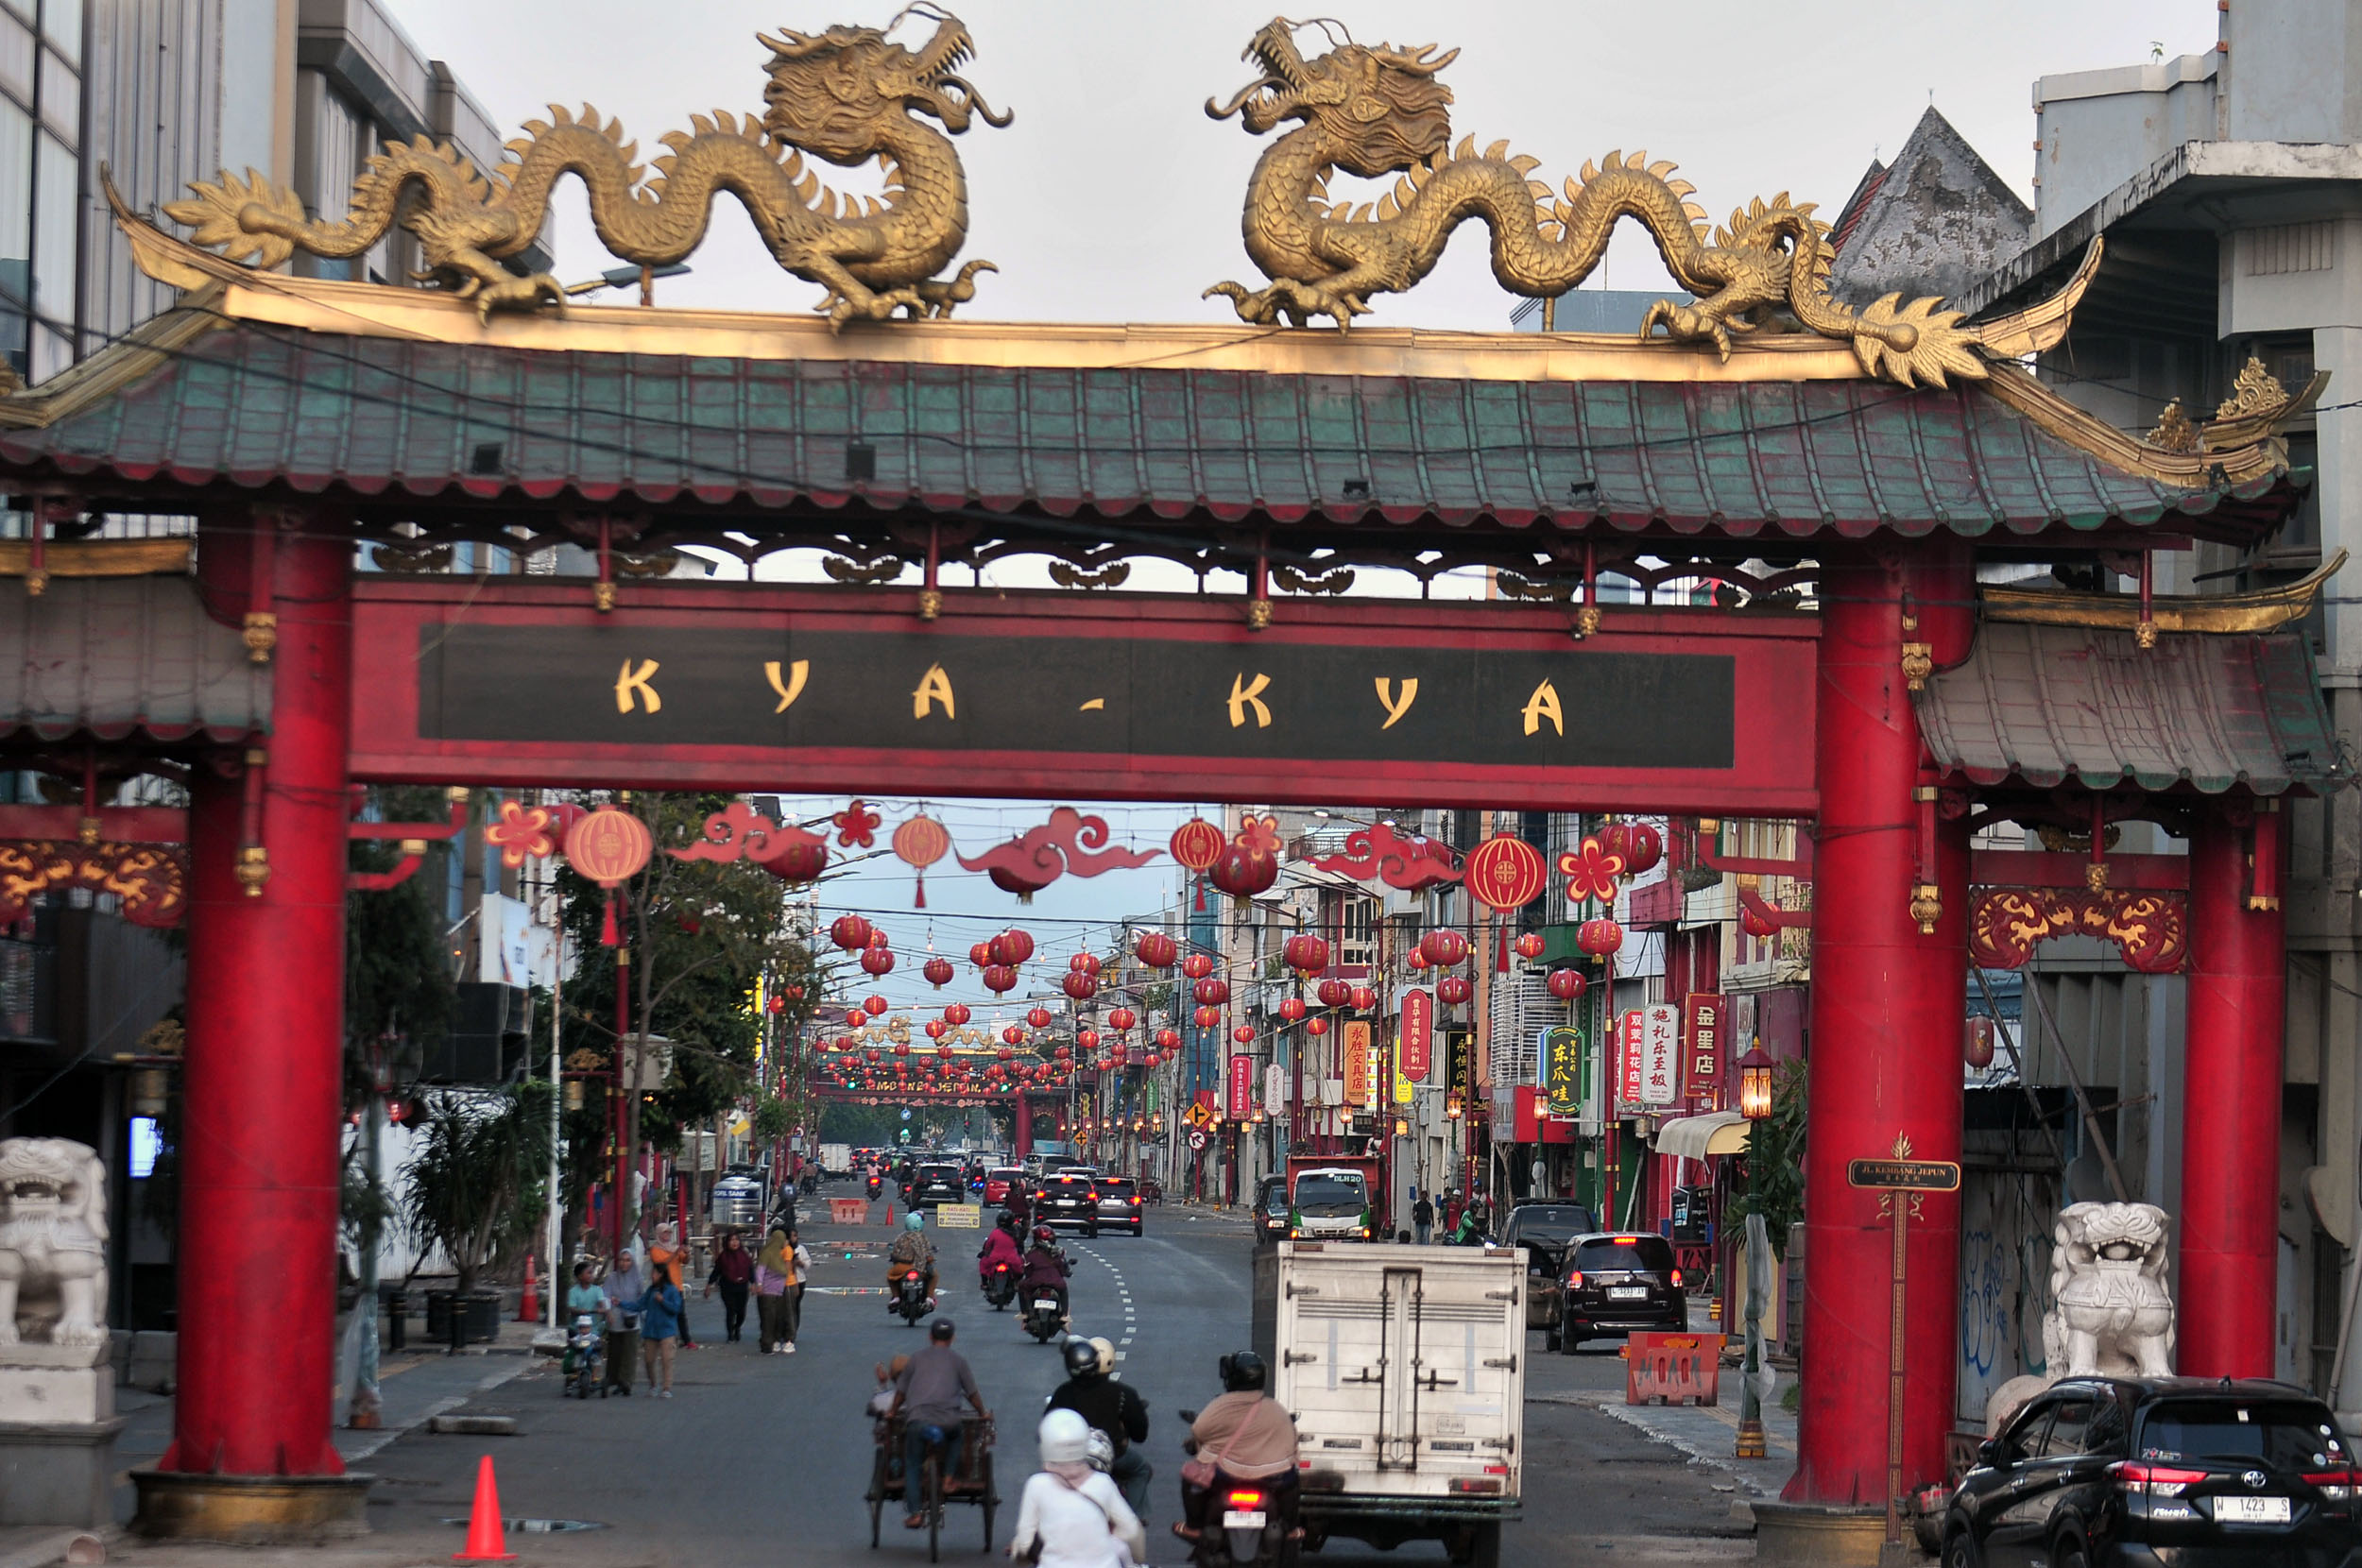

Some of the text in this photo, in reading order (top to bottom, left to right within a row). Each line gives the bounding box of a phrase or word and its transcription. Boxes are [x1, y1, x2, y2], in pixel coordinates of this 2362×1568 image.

[1351, 1027, 1364, 1089] 永胜文具店
[1694, 1006, 1716, 1074] 金里店
[1551, 1043, 1571, 1101] 东爪哇
[1875, 1165, 1916, 1176] KEMBANG
[1917, 1167, 1946, 1177] JEPUN
[2216, 1497, 2288, 1512] W 1423 S
